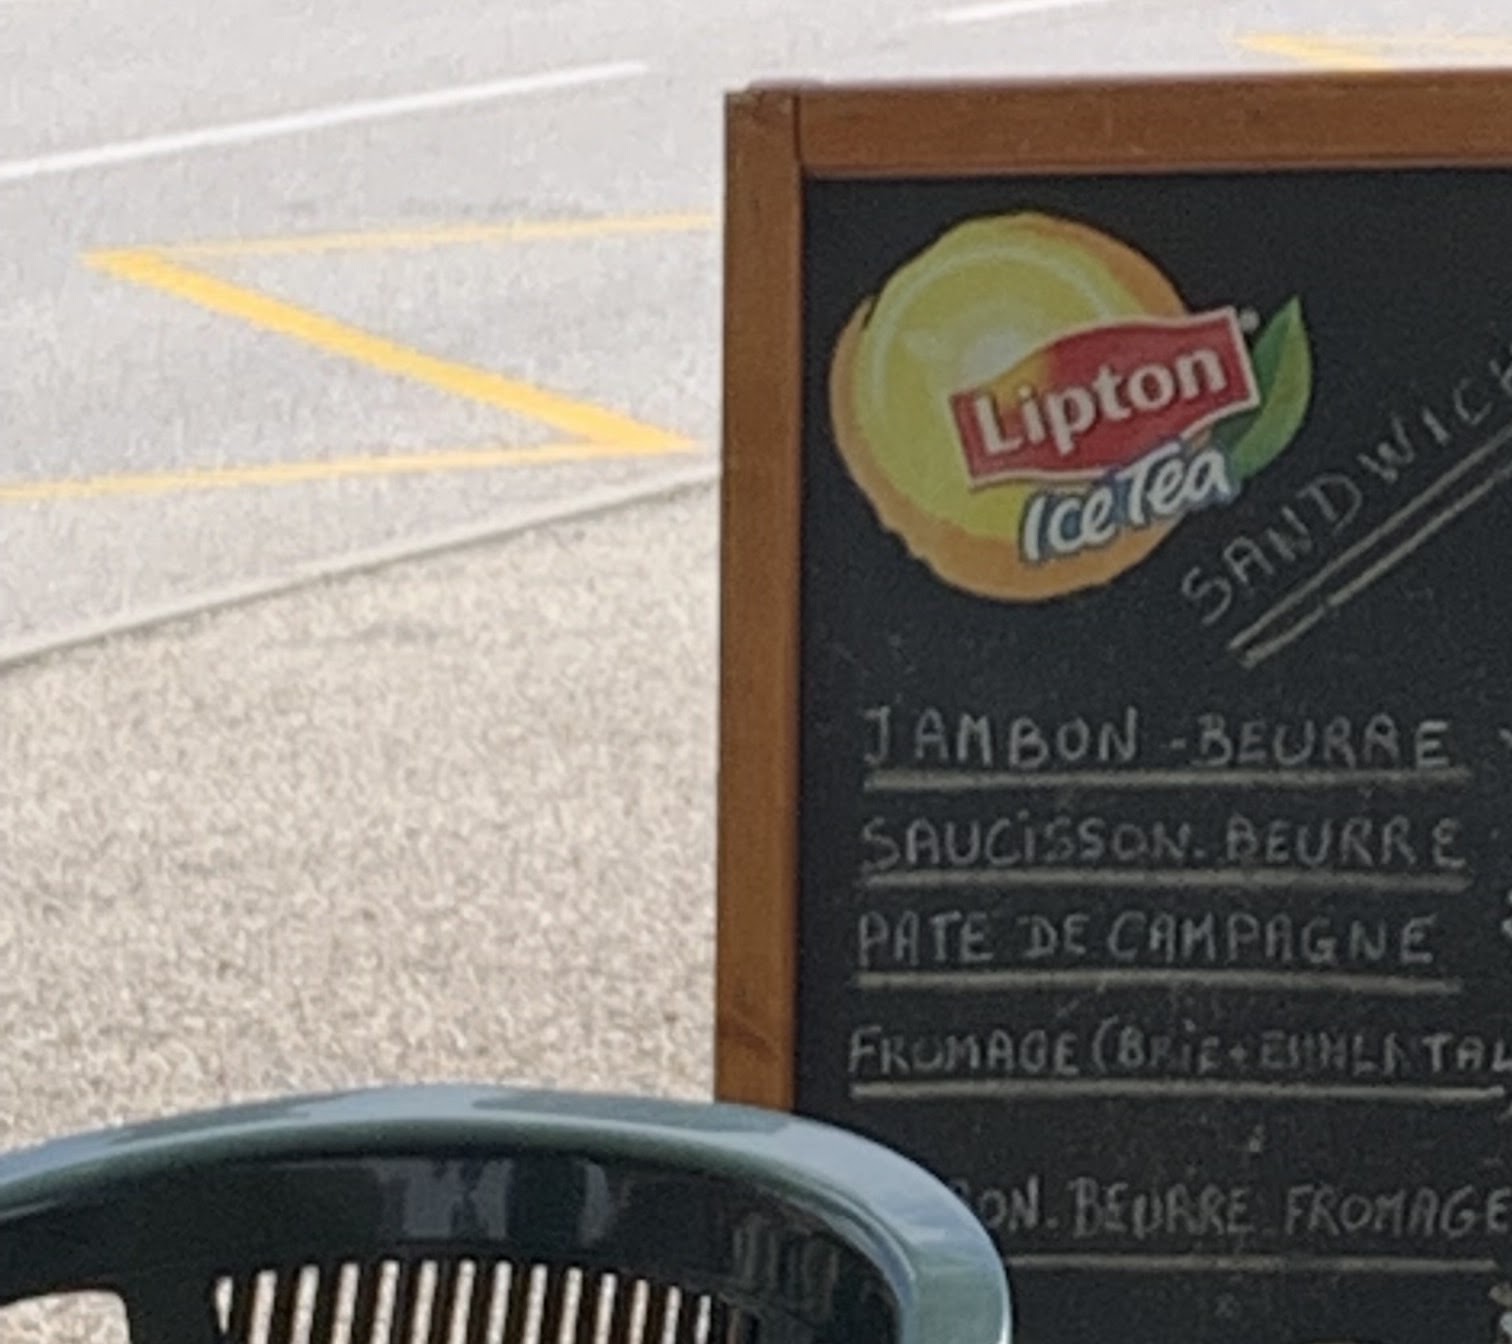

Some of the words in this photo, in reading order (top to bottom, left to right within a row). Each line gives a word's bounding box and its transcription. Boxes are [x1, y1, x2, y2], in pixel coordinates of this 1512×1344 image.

[975, 342, 1229, 458] Lipton
[858, 910, 994, 967] PATE
[1016, 914, 1090, 957] DE
[1106, 911, 1438, 963] CAMPAGNE
